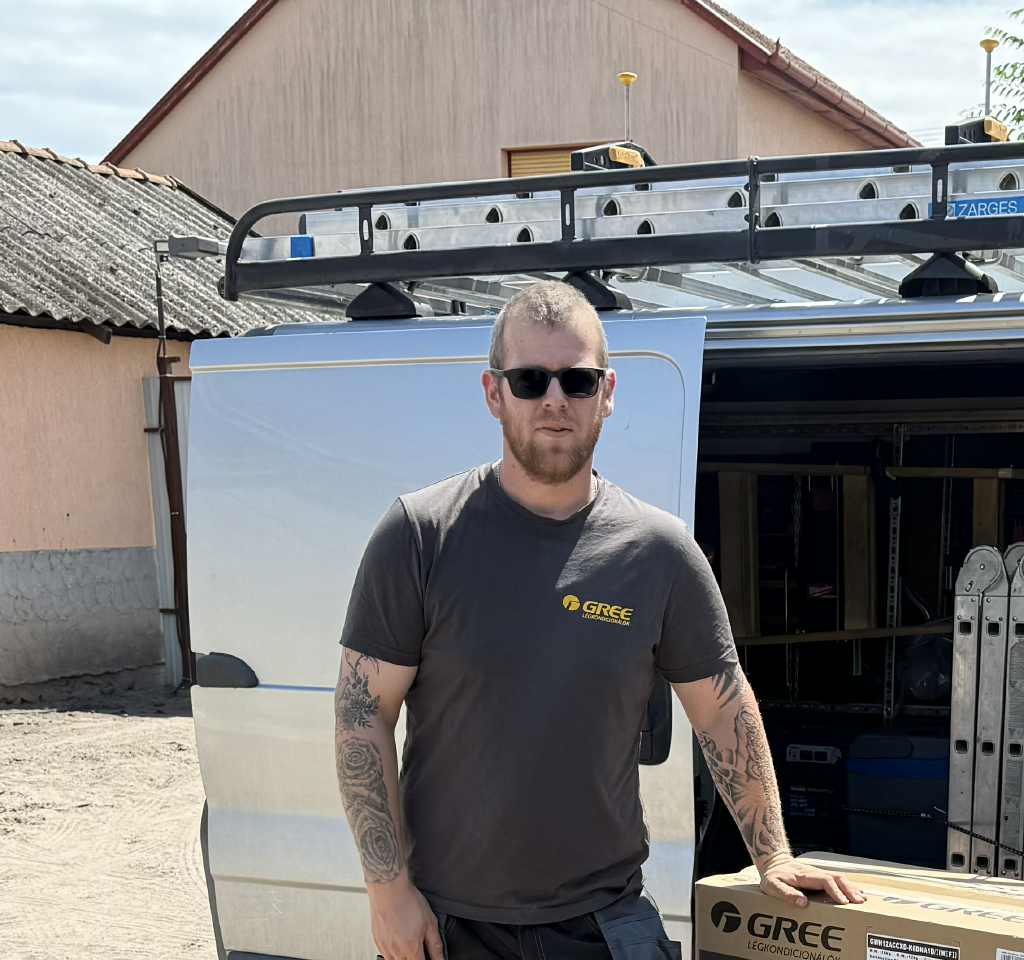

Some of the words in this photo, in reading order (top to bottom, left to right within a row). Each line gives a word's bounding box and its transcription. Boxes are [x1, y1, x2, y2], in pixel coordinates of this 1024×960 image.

[958, 200, 1018, 217] ZARGES
[582, 600, 634, 620] GREE
[747, 912, 846, 952] GREE
